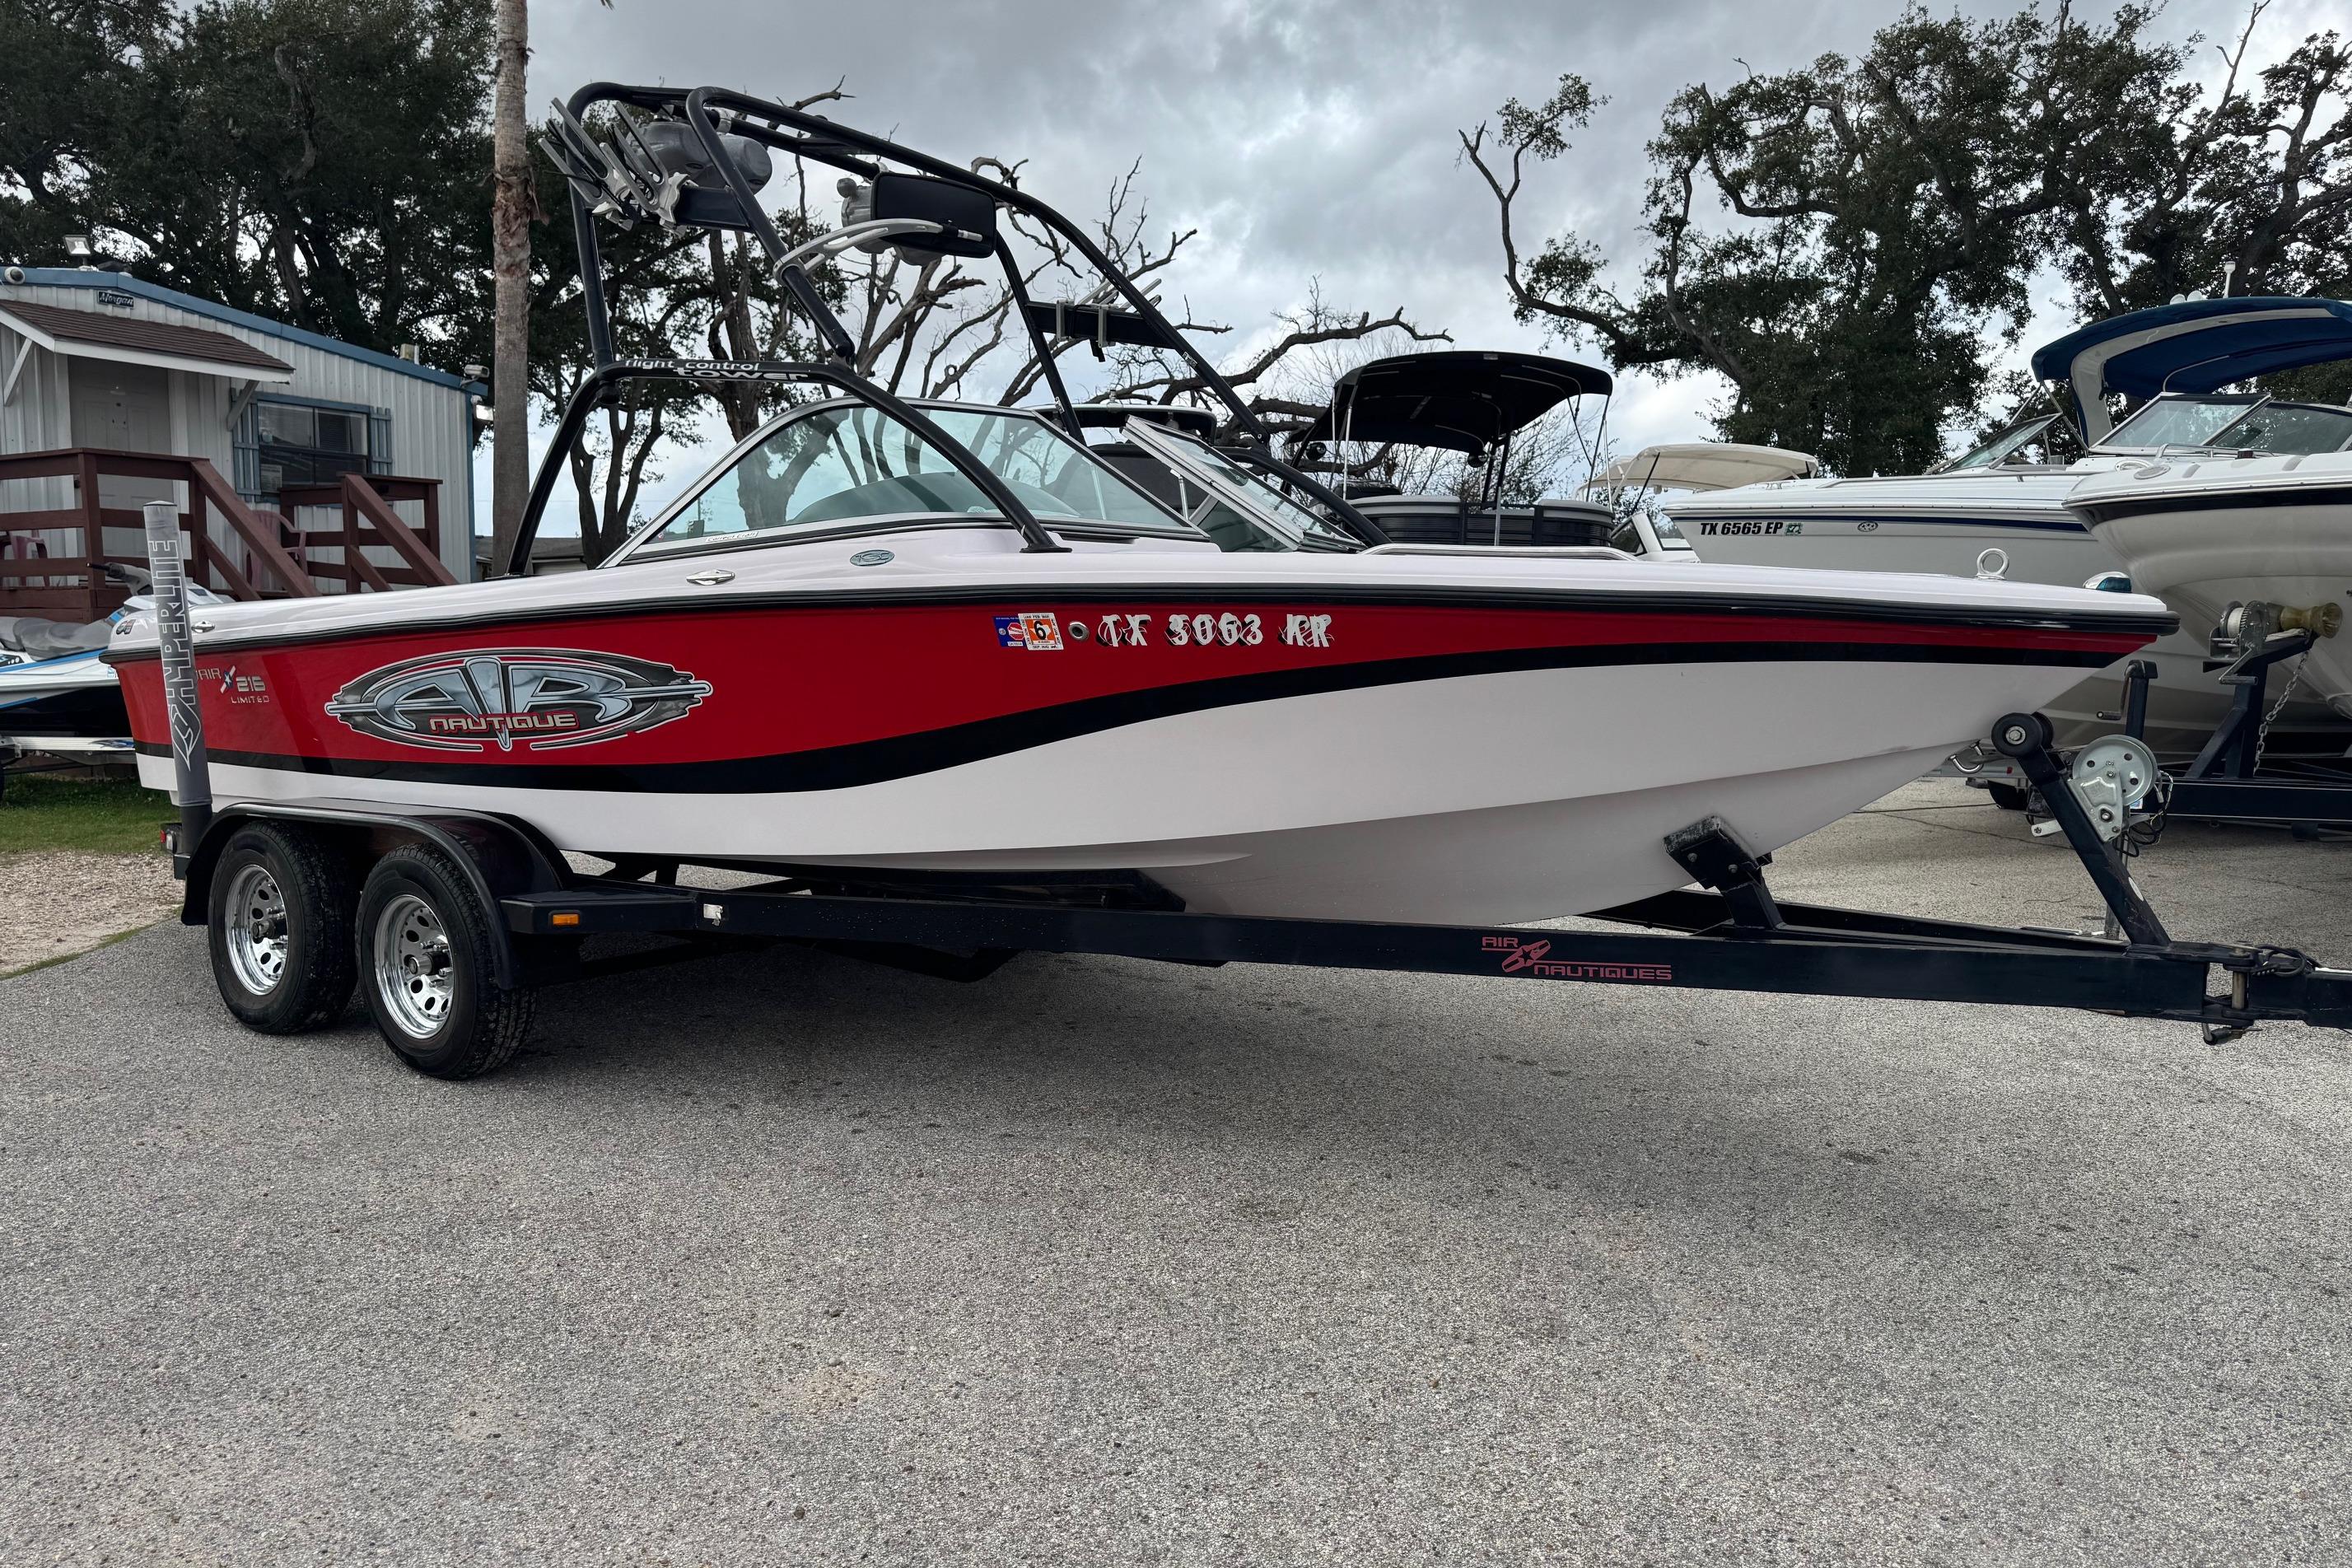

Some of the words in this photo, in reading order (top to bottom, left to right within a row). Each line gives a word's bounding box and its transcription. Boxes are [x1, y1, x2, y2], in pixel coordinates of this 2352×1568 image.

[100, 292, 133, 306] Morgan
[625, 359, 674, 370] flight
[685, 362, 759, 371] control
[673, 367, 809, 380] tower
[1700, 522, 1719, 535] TX
[1720, 522, 1762, 535] 6565
[1764, 522, 1784, 534] EP
[148, 539, 197, 706] HYPERLITE
[1034, 620, 1047, 640] 6
[236, 676, 266, 692] 216
[231, 695, 270, 704] LIMITED
[428, 713, 579, 733] NAUTIQUE
[1482, 936, 1519, 948] AIR
[1533, 965, 1673, 981] NAUTIQUES
